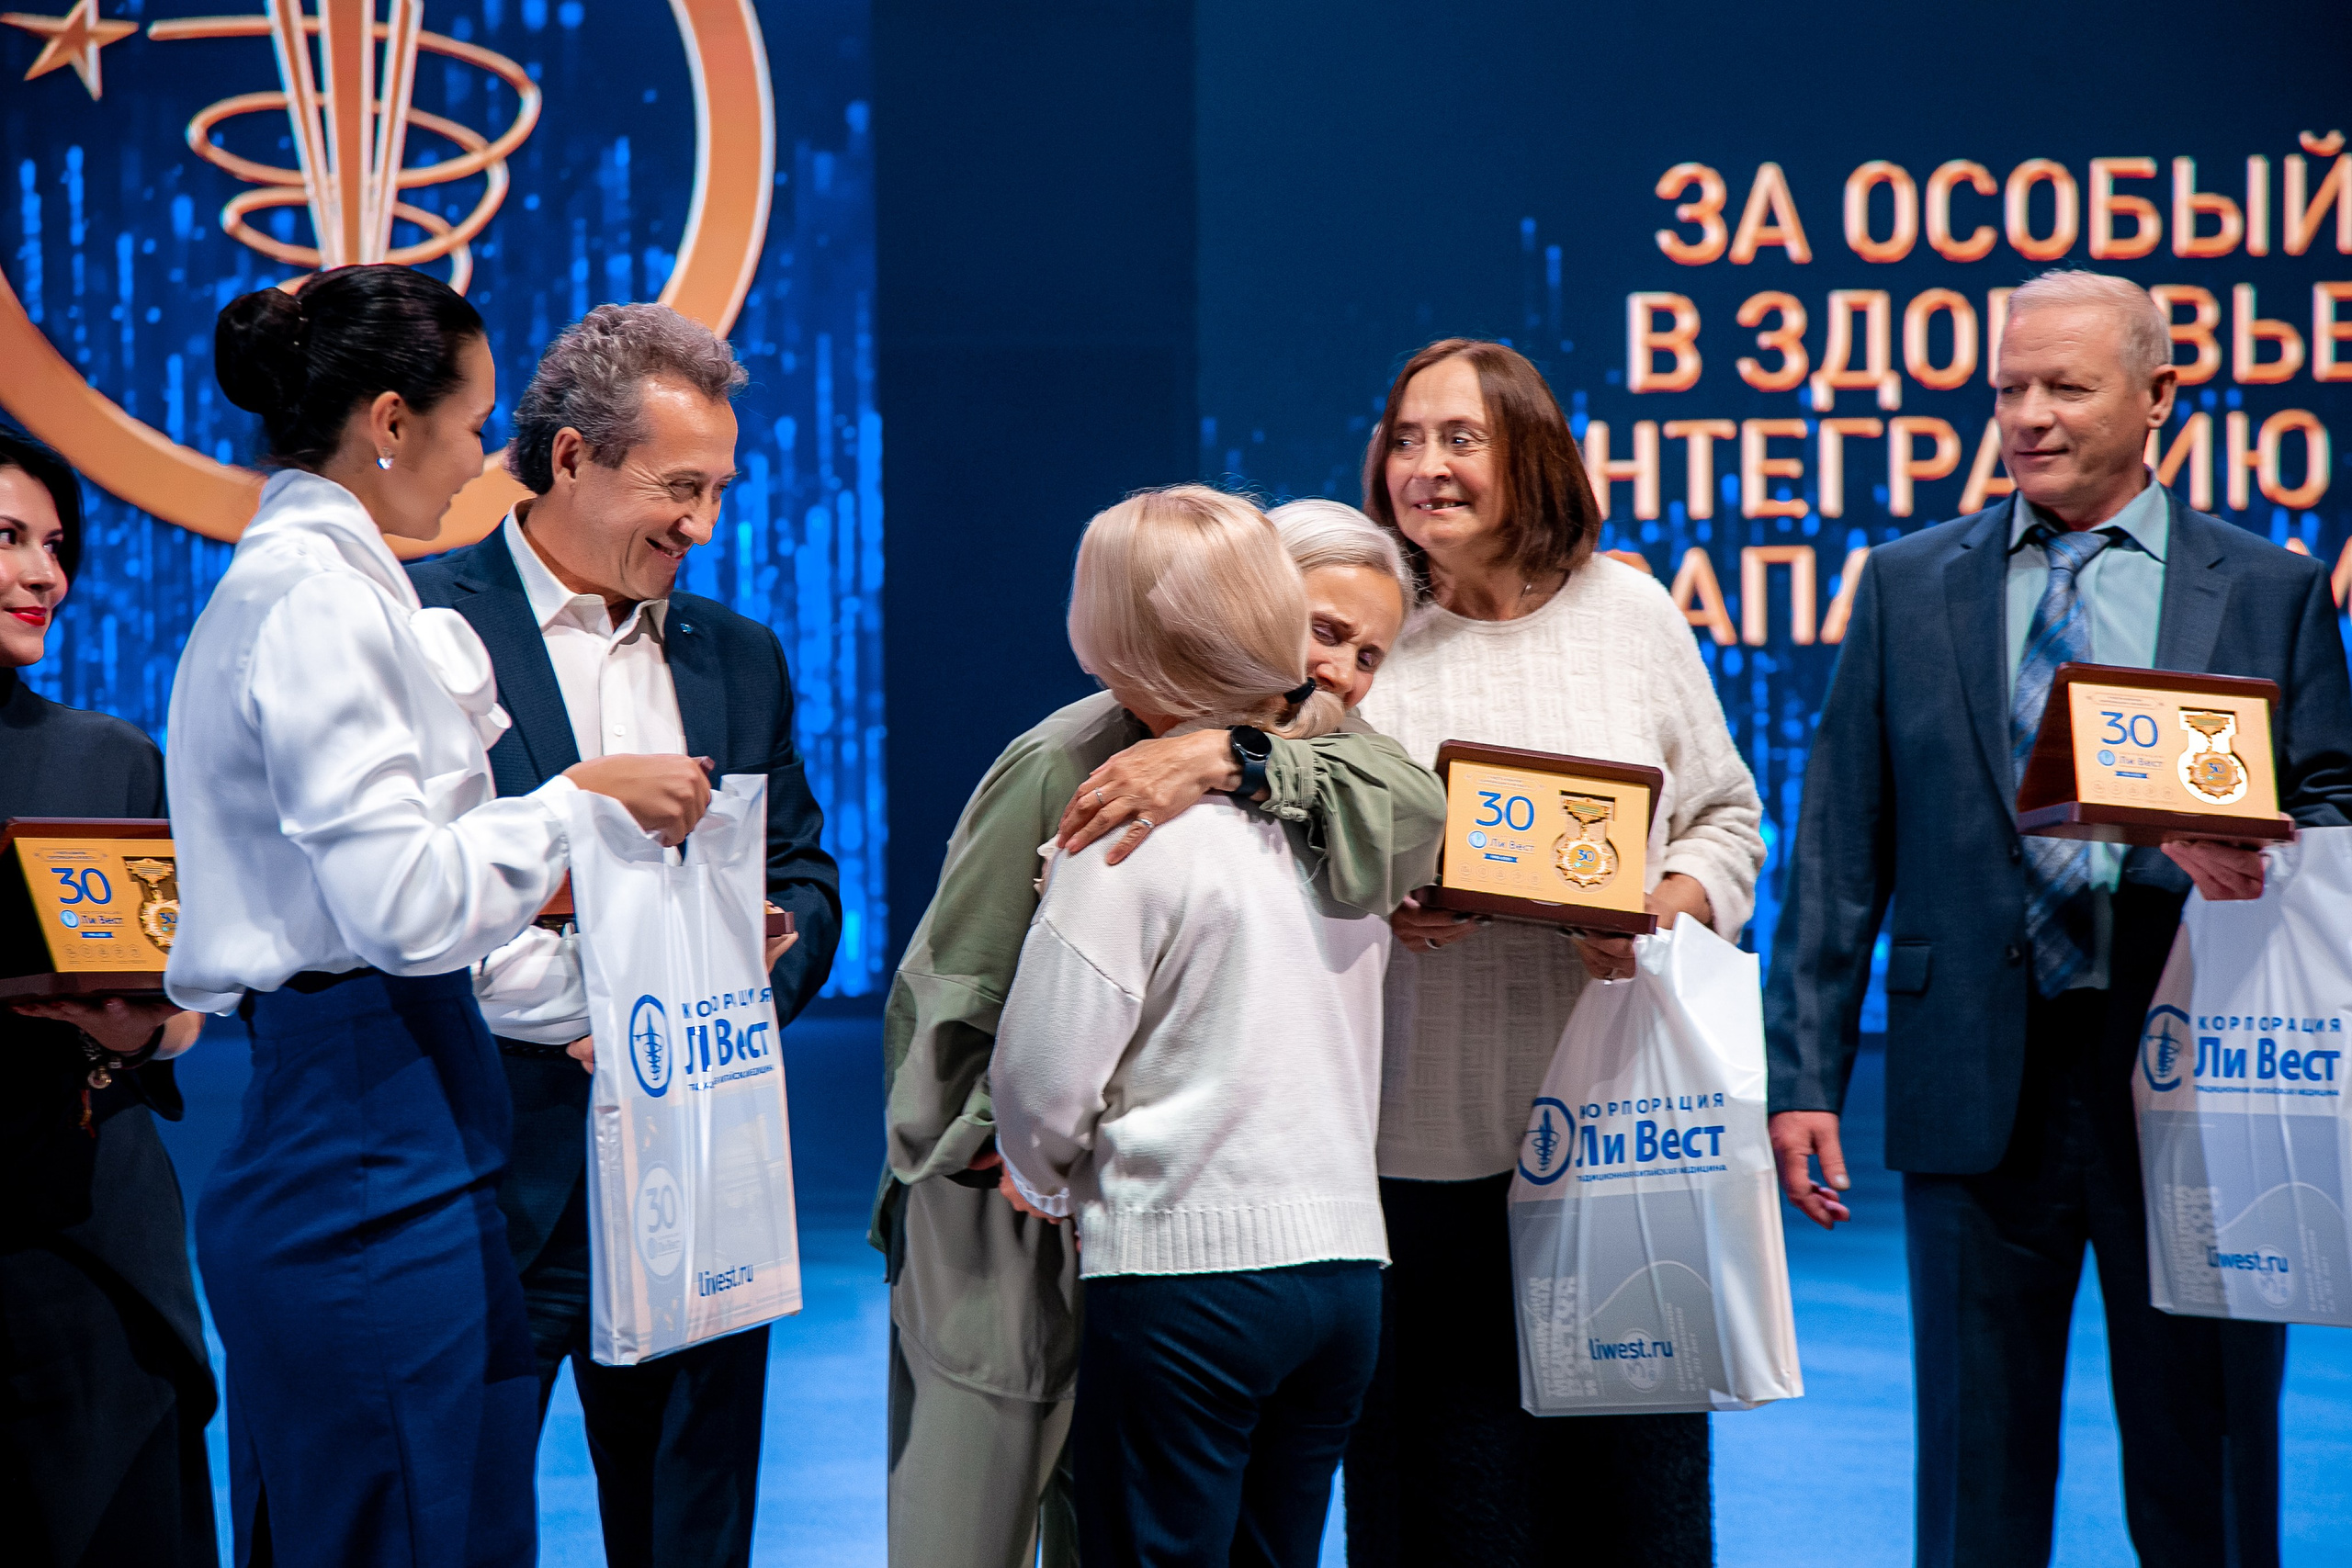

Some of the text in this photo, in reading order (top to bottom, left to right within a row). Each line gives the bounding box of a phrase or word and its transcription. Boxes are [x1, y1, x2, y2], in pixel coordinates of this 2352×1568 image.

[1655, 130, 2352, 265] ЗА ОСОБЫЙ
[1626, 281, 2352, 412] В ЗДОВЬЕ
[2099, 711, 2158, 748] 30
[1475, 790, 1534, 831] 30
[1577, 849, 1595, 862] 30
[51, 867, 112, 905] 30
[2194, 1036, 2341, 1082] Ли Вест
[1575, 1119, 1726, 1168] Ли Вест
[646, 1184, 677, 1234] 30
[1588, 1337, 1673, 1361] liwest.ru
